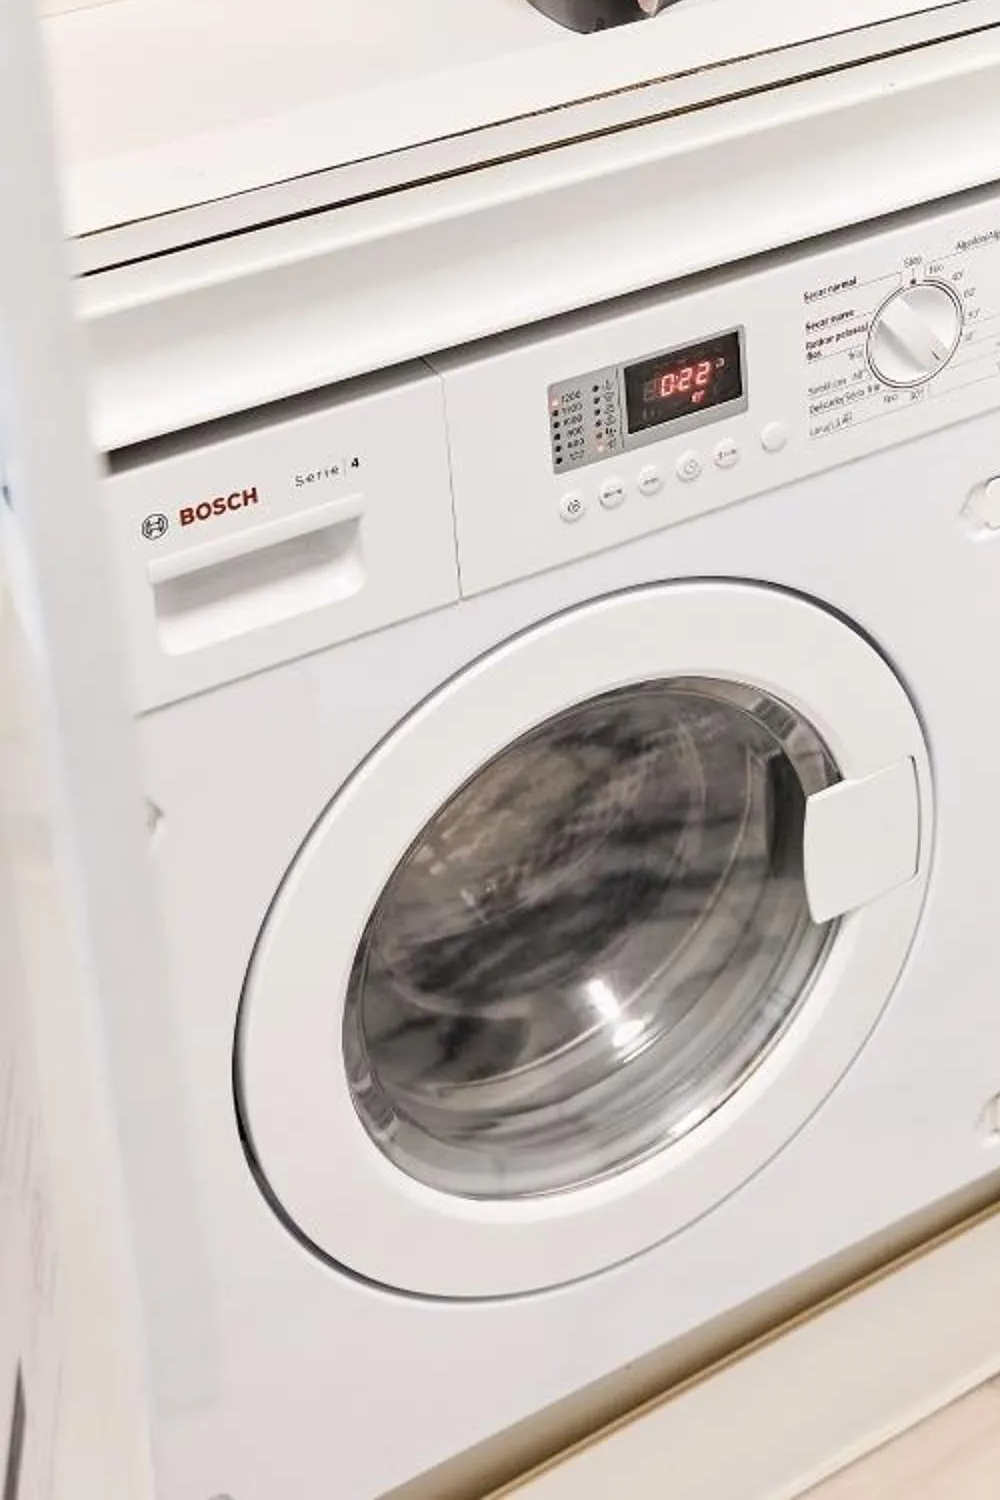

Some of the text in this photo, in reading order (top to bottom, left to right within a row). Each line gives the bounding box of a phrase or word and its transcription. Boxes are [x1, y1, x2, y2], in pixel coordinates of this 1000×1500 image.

[295, 456, 361, 487] Serie 4
[178, 486, 260, 527] BOSCH
